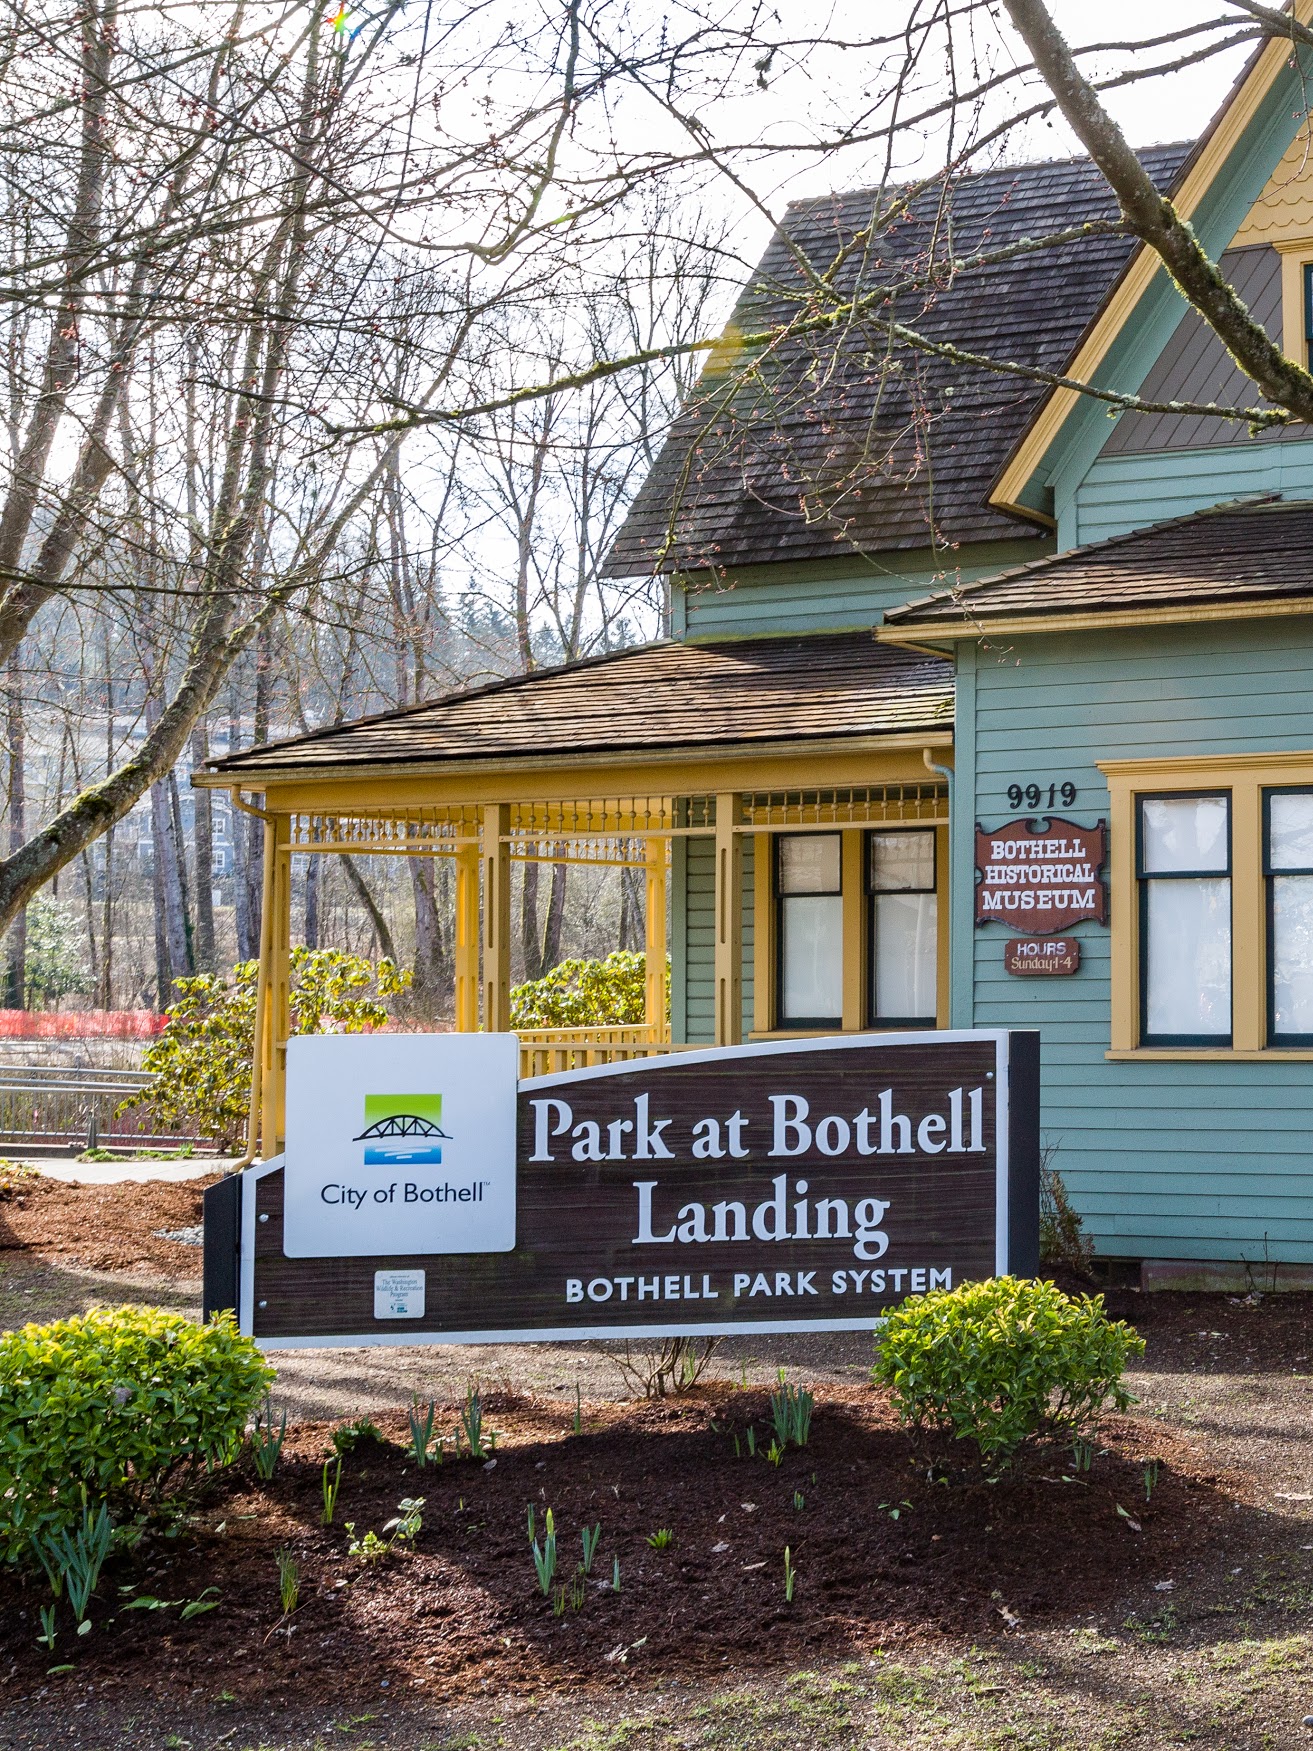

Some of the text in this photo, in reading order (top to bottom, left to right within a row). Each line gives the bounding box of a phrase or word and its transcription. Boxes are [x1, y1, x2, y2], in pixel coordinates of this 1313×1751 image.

[1007, 781, 1077, 809] 9919
[990, 838, 1086, 860] BOTHELL
[985, 863, 1095, 885] HISTORICAL
[982, 888, 1096, 910] MUSEUM
[1017, 942, 1067, 956] HOURS
[528, 1086, 987, 1162] Park at Bothell
[320, 1184, 368, 1210] City
[373, 1183, 398, 1203] of
[632, 1173, 891, 1260] Landing
[566, 1267, 953, 1303] BOTHELL PARK SYSTEM
